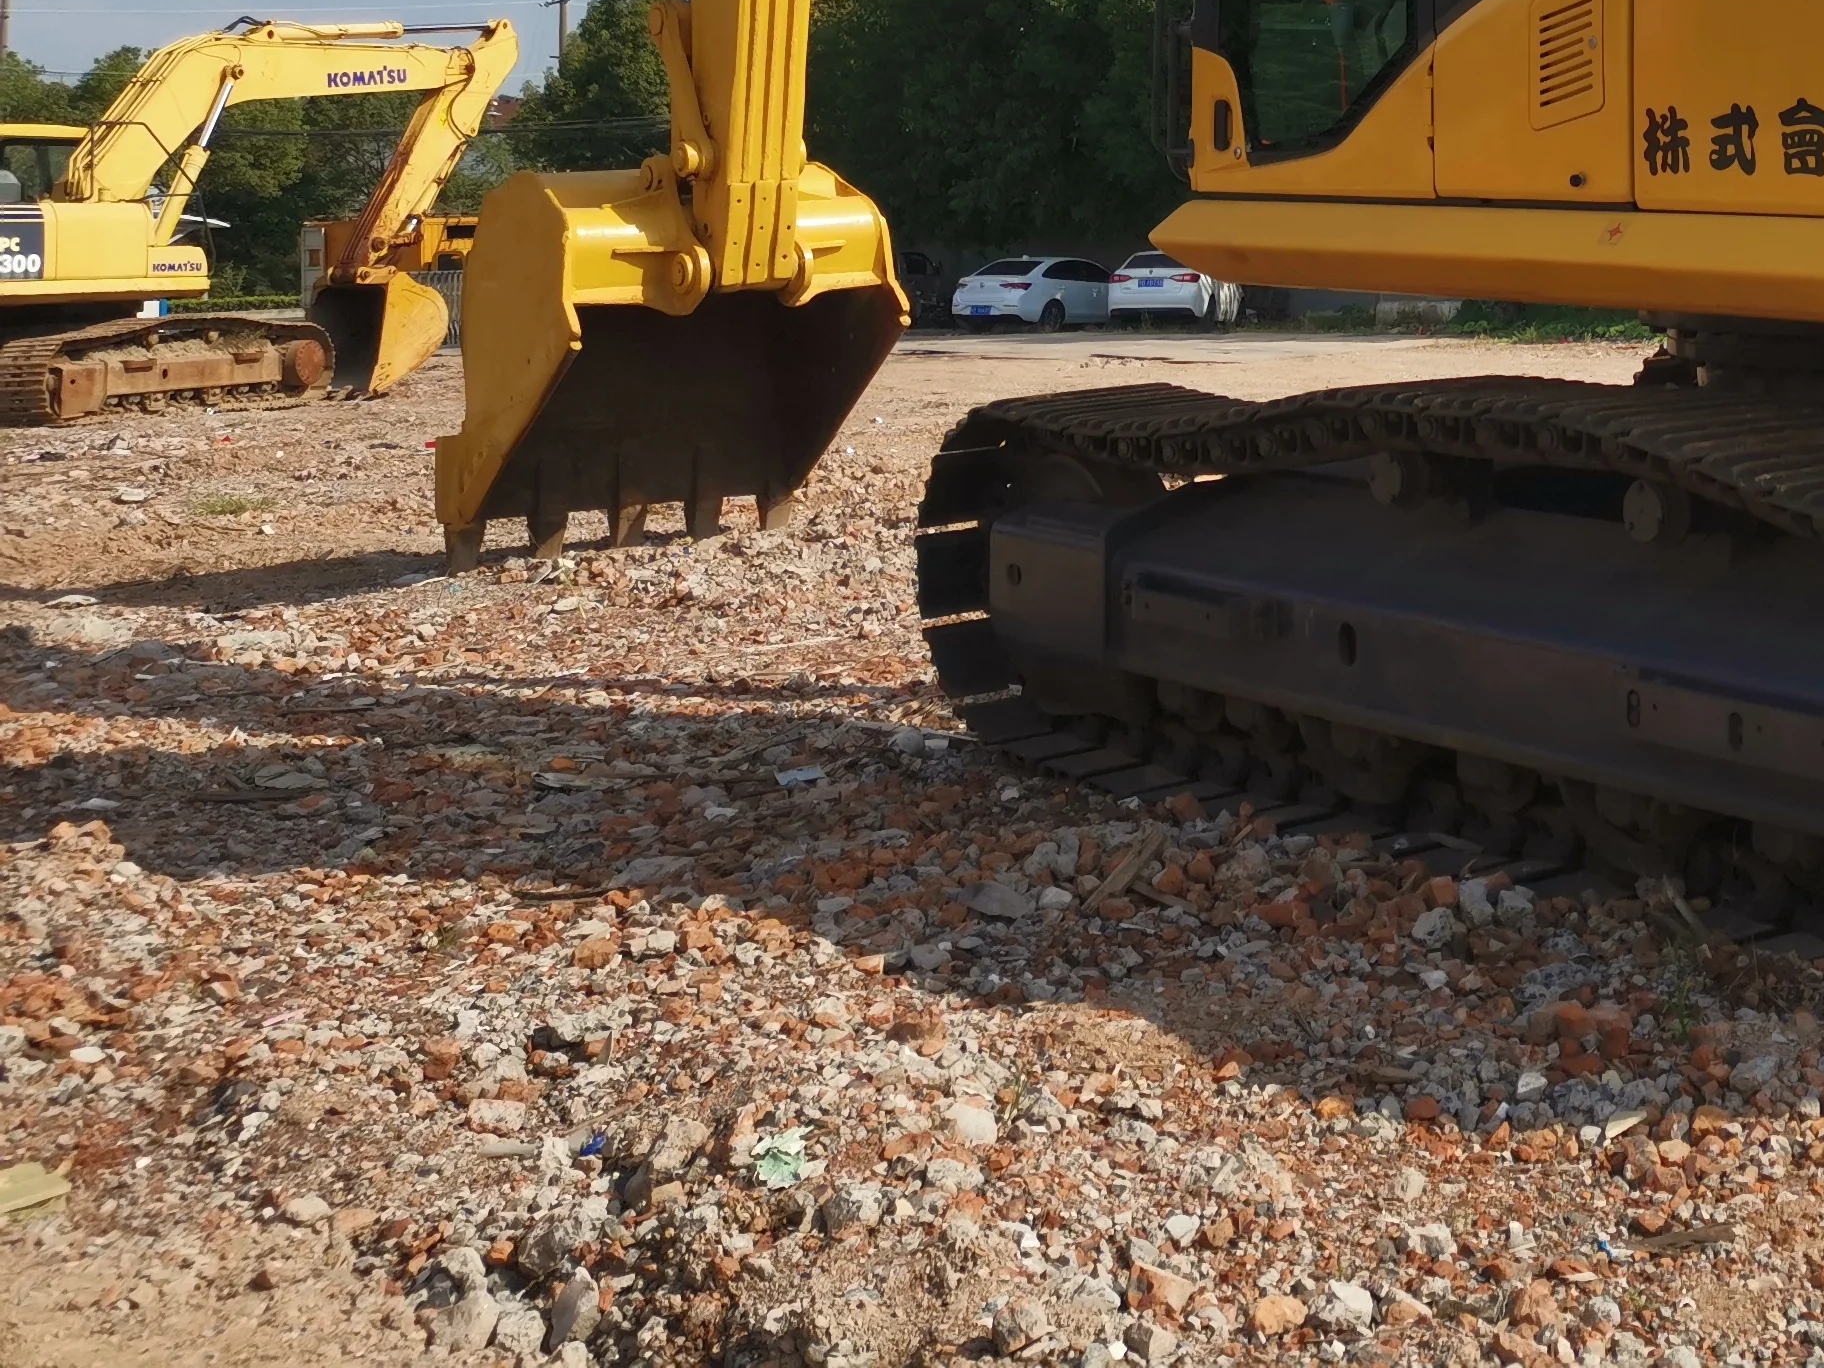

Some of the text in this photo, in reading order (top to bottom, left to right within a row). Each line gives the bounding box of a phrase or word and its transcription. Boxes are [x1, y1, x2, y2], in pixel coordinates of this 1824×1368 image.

[327, 65, 407, 88] KOMATSU
[0, 236, 20, 252] PC
[0, 253, 42, 273] 300
[152, 260, 202, 272] KOMATSU
